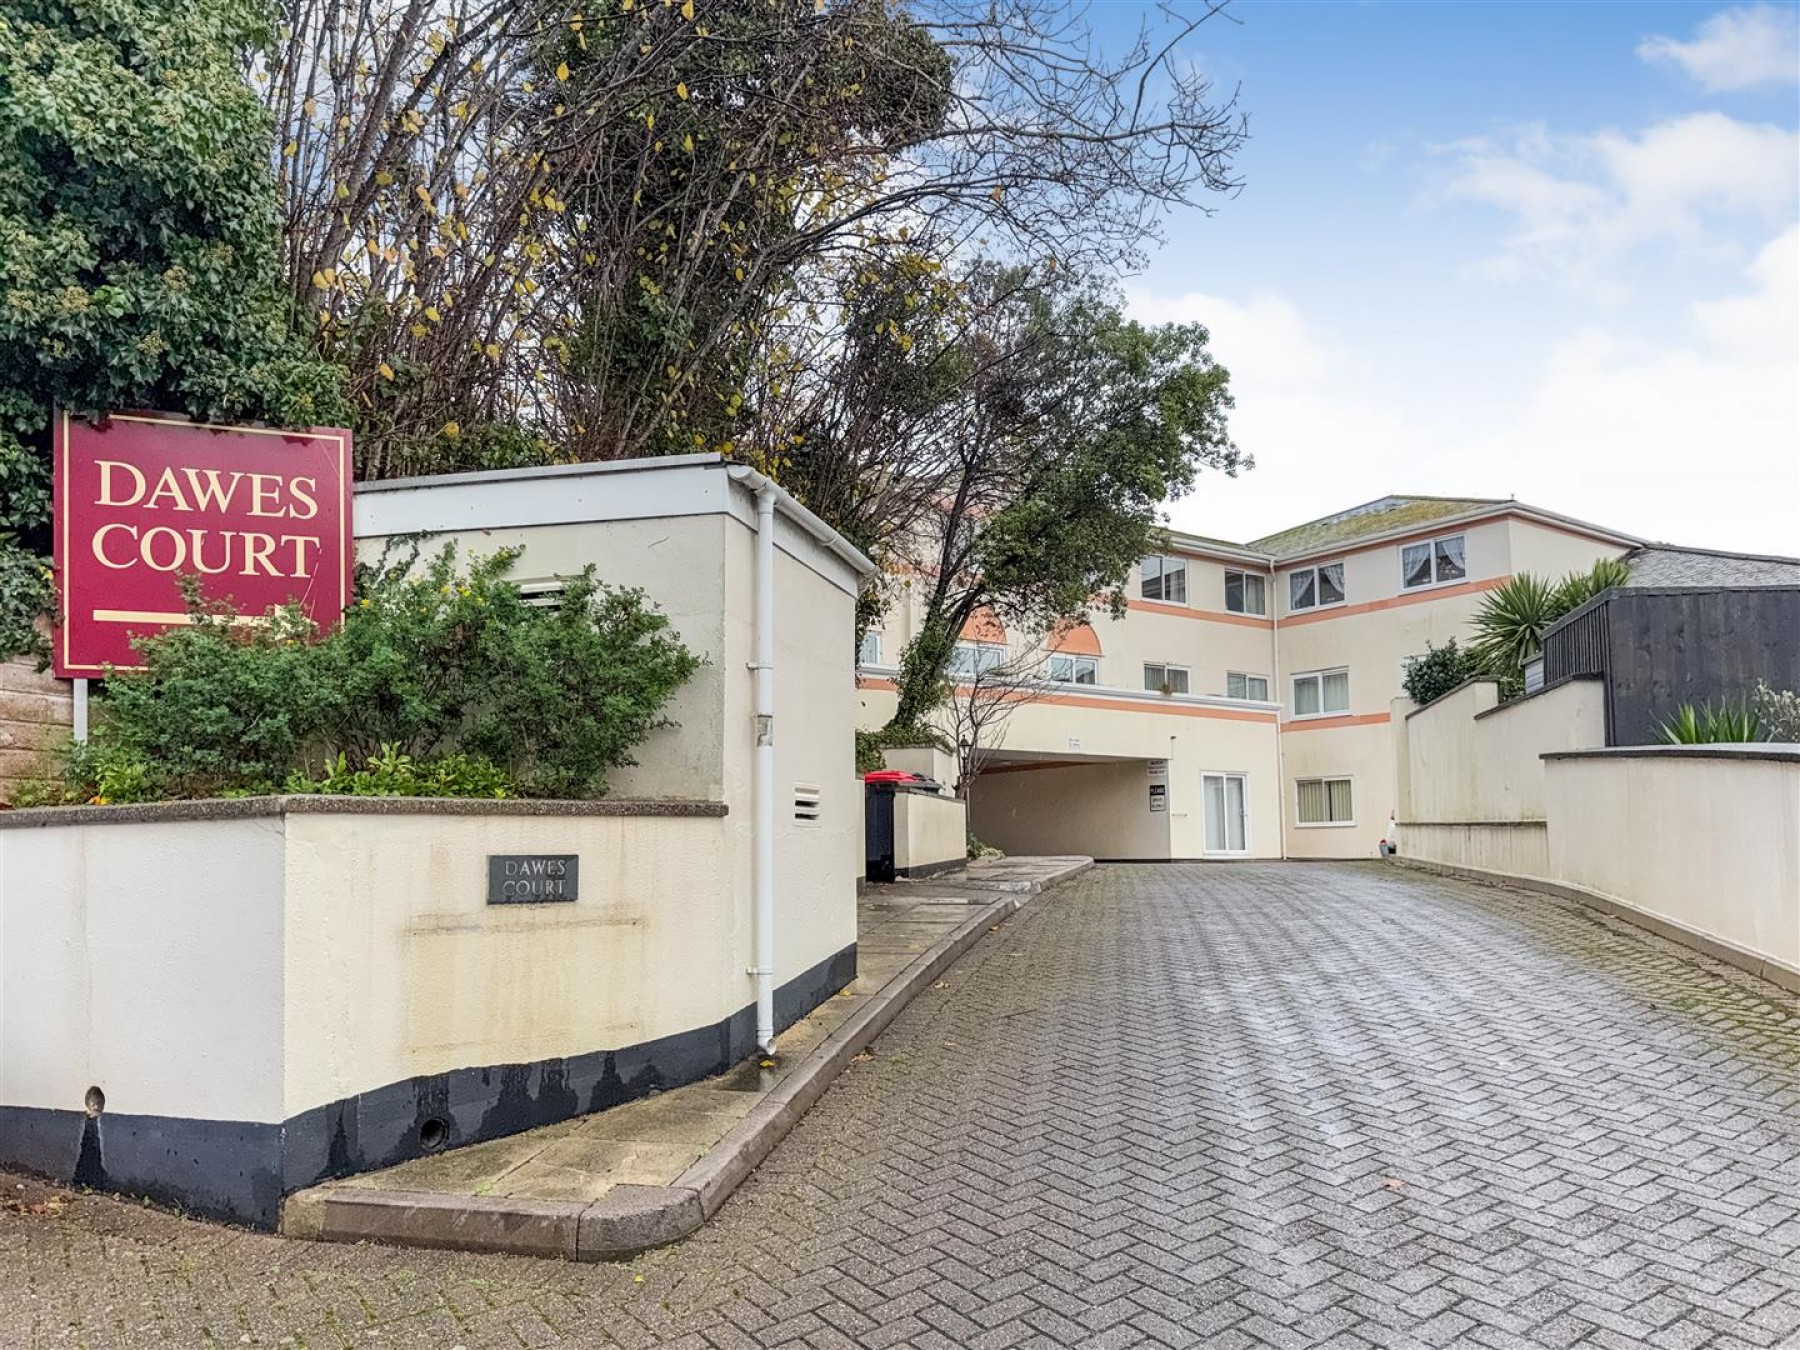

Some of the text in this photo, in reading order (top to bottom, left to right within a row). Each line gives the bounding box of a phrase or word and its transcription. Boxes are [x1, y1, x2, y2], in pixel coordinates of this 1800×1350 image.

[94, 460, 319, 520] DAWES
[92, 523, 321, 579] COURT
[505, 860, 566, 876] DAWES
[502, 880, 566, 896] COURT
